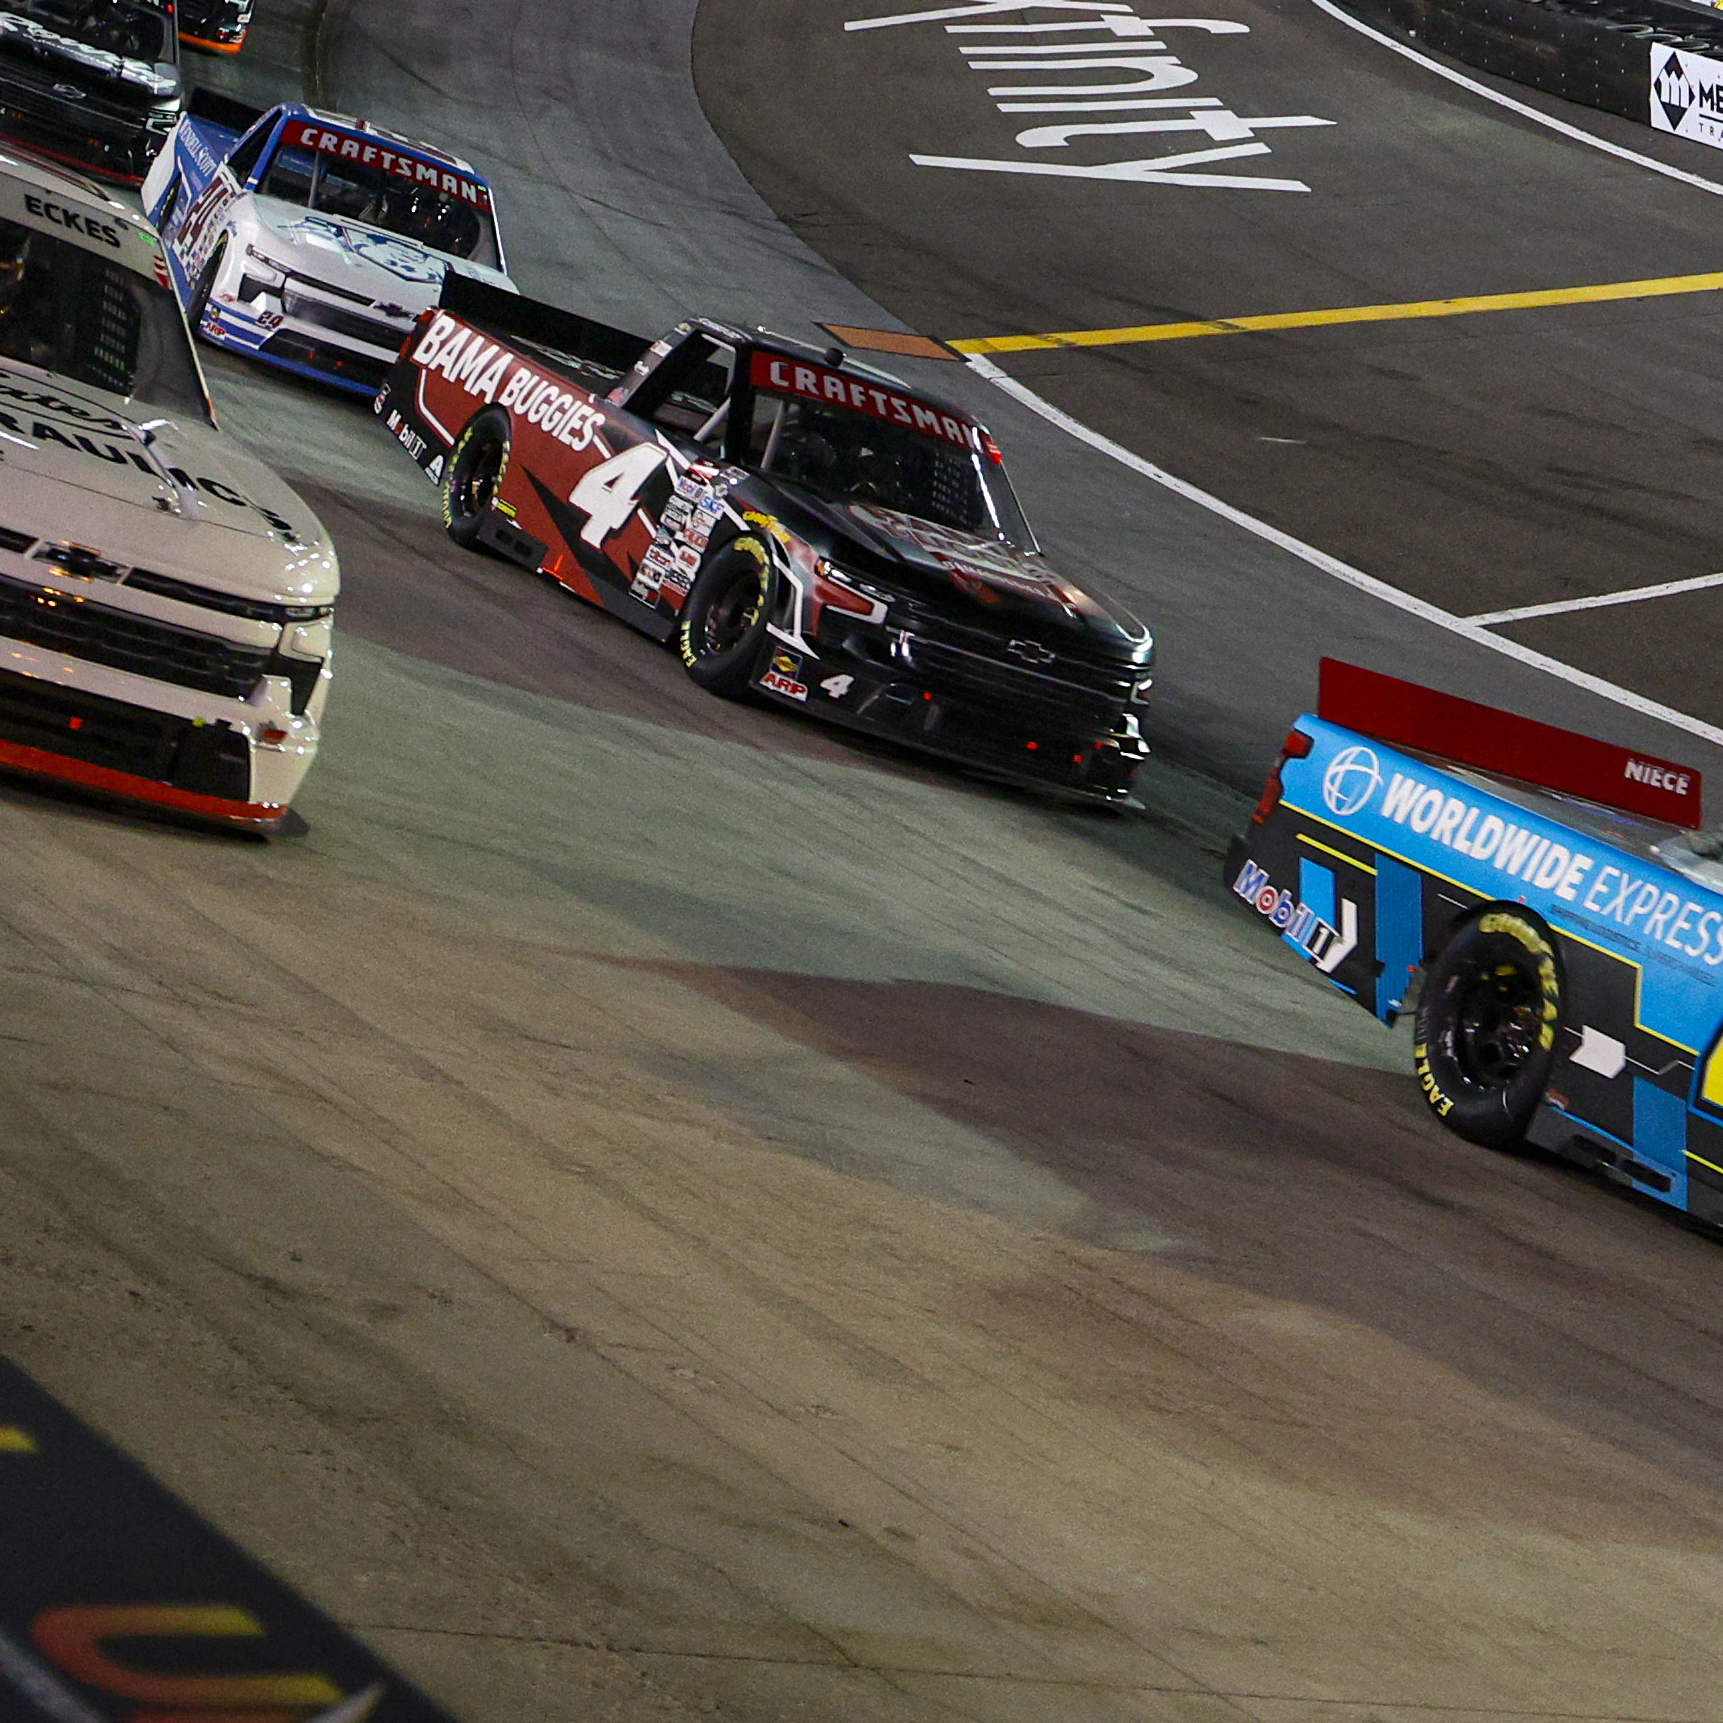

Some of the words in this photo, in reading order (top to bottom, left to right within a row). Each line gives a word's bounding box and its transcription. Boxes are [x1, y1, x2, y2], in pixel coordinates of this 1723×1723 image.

[196, 148, 218, 177] SCOTT
[300, 127, 478, 203] CRAFTSMAN
[23, 192, 121, 250] ECKES
[205, 320, 227, 339] ARP
[255, 310, 285, 329] 24
[411, 312, 515, 405] BAMA
[498, 366, 607, 452] BUGGIES
[769, 361, 980, 453] CRAFTSMAN
[567, 440, 673, 550] 4
[760, 670, 809, 702] ARP
[820, 674, 855, 700] 4
[1624, 757, 1690, 796] NIECE
[1377, 772, 1595, 905] WORLDWIDE
[1231, 857, 1320, 957] Mobil
